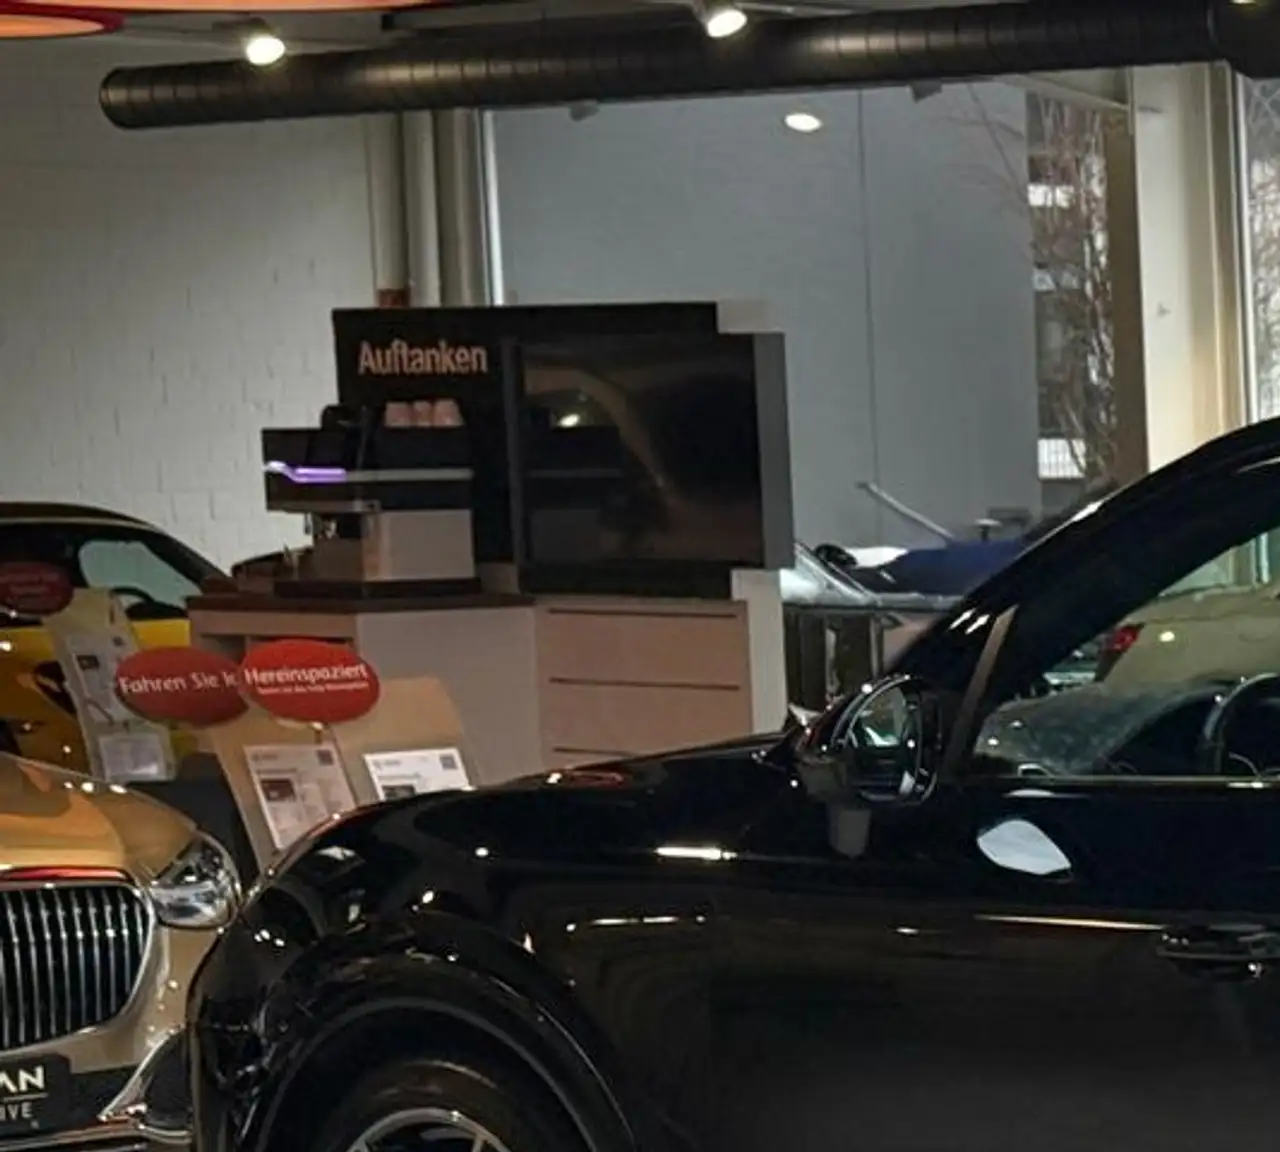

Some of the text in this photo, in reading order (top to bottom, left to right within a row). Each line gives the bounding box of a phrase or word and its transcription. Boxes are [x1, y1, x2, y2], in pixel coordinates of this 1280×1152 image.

[358, 338, 488, 375] Auftanken
[119, 674, 187, 695] Fahren
[190, 671, 220, 690] Sie
